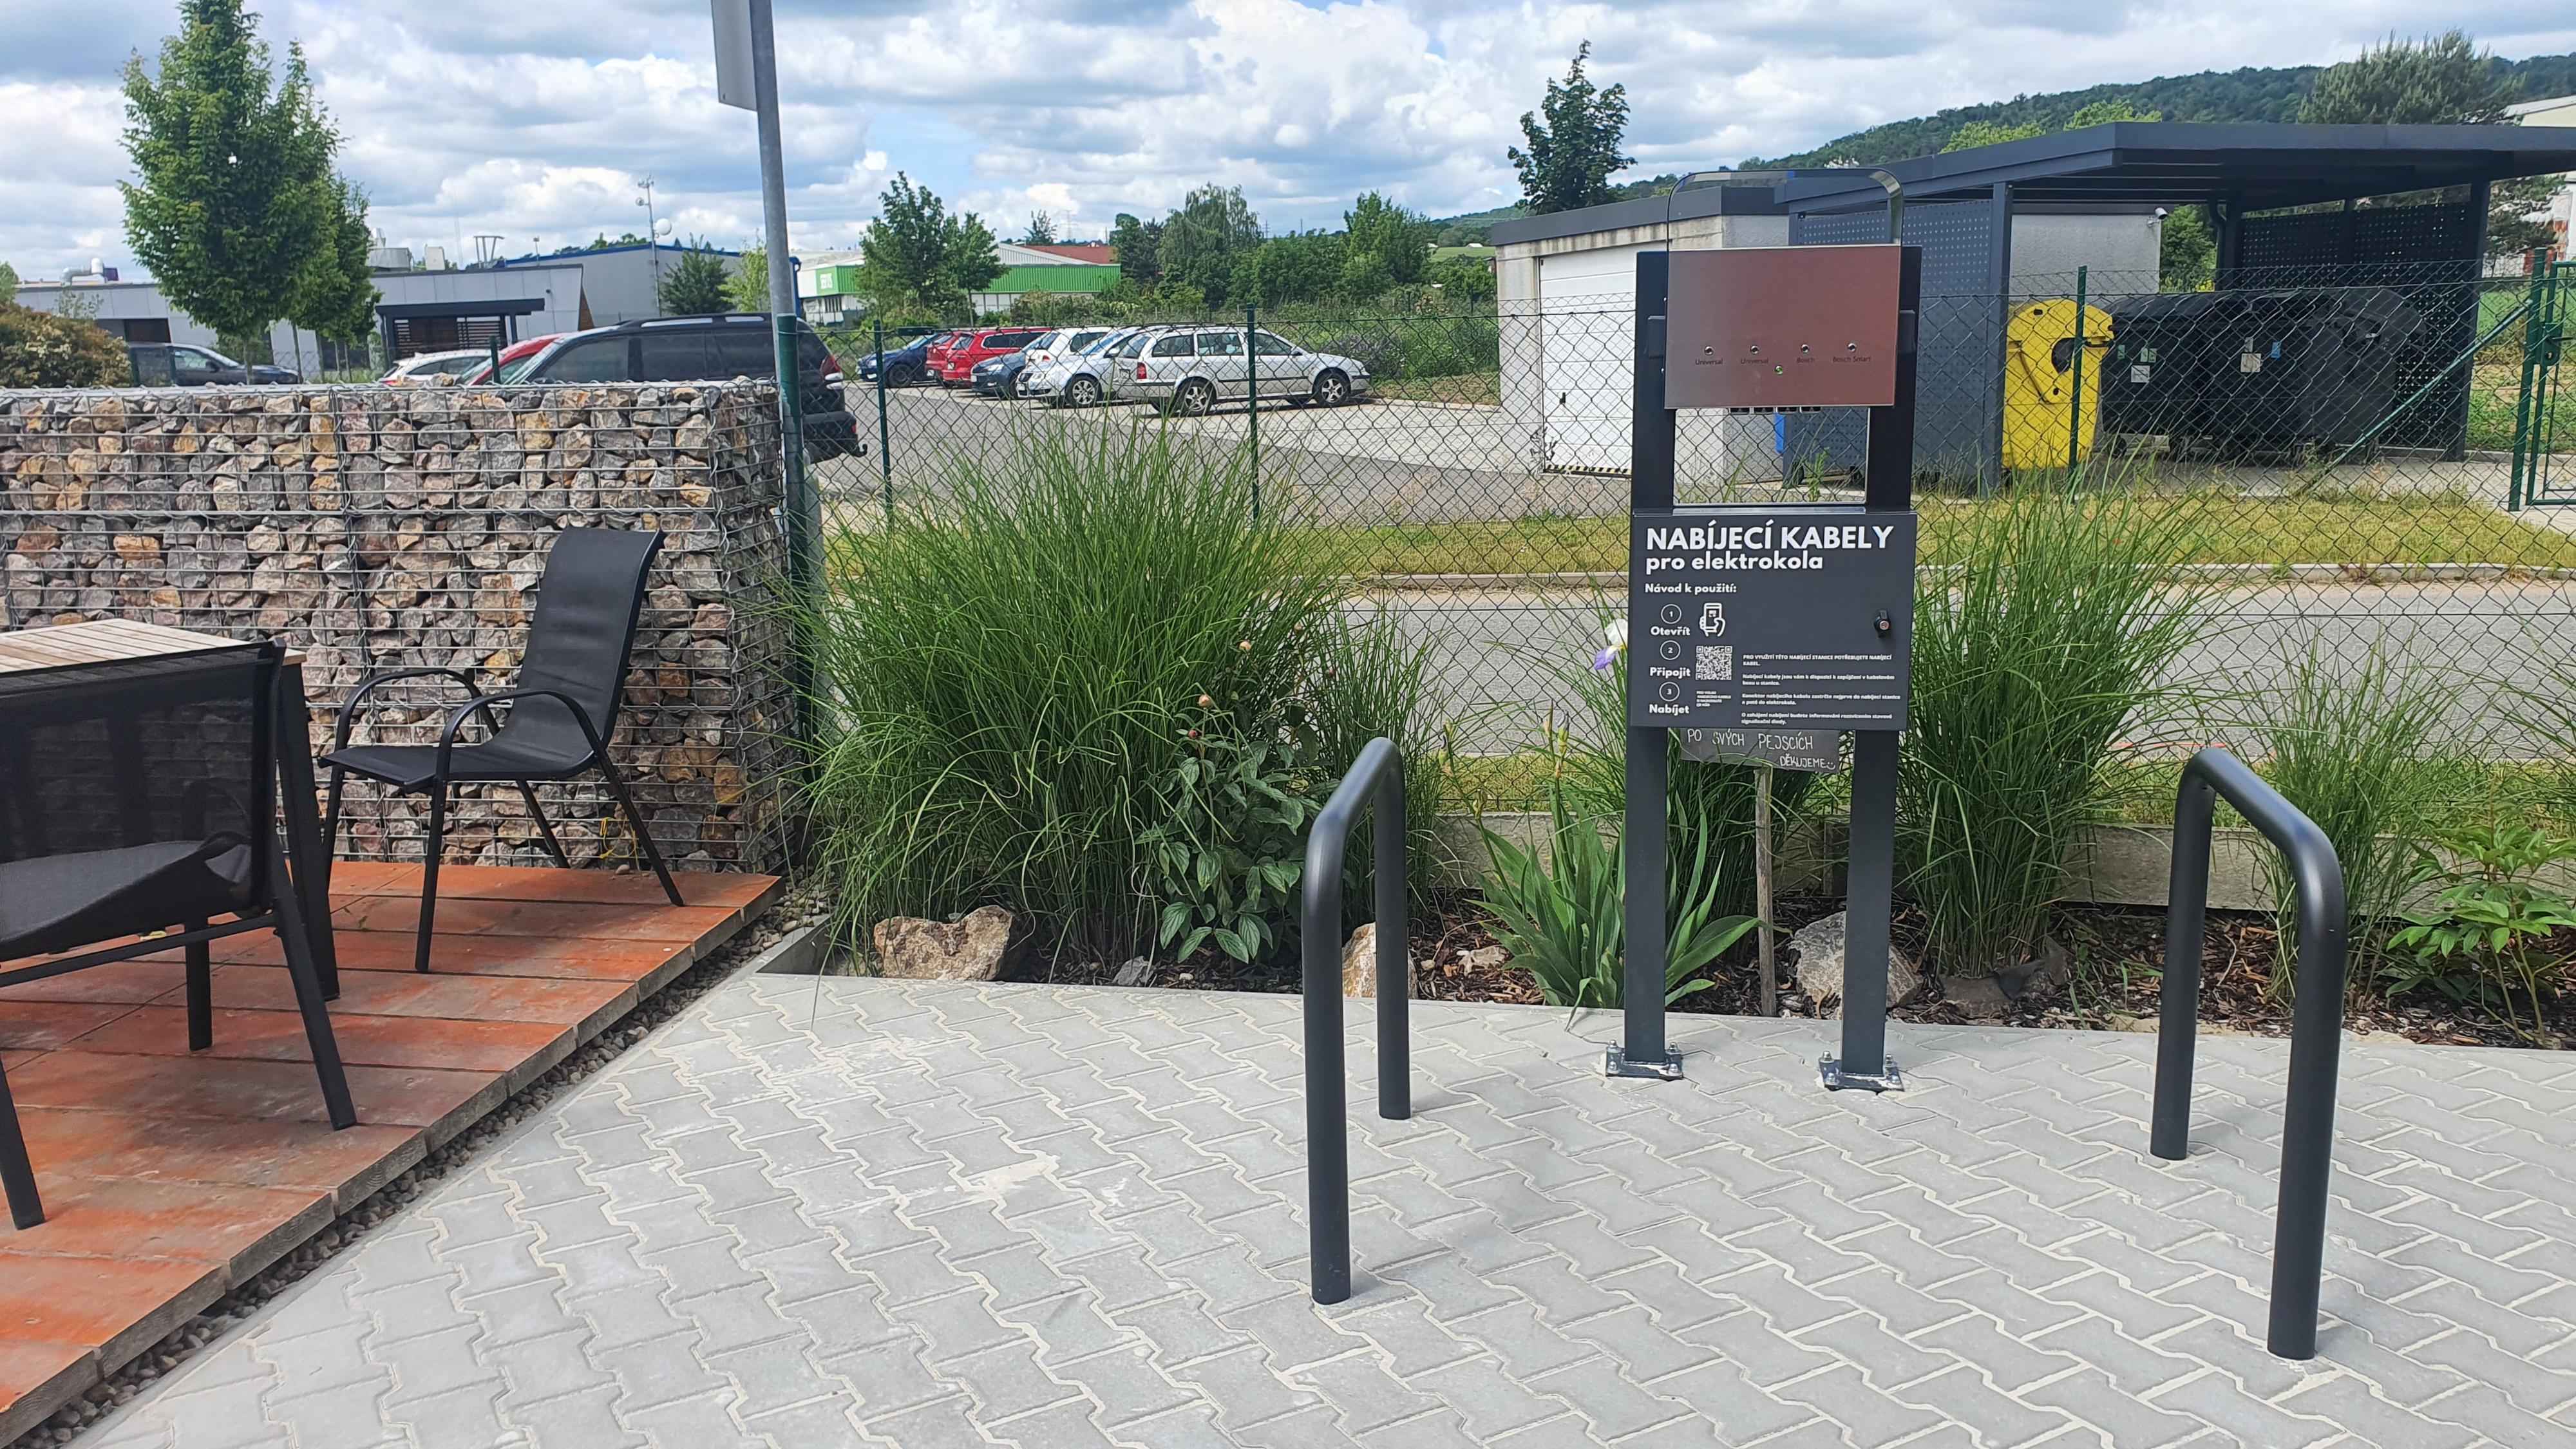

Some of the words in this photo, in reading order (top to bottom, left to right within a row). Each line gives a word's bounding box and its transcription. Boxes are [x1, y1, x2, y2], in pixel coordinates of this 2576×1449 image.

[1647, 519, 1774, 550] NABÍJECÍ
[1781, 526, 1894, 549] KABELY
[1646, 558, 1685, 575] pro
[1691, 550, 1823, 570] elektrokola
[1645, 583, 1682, 593] Návod
[1685, 583, 1692, 593] k
[1694, 583, 1737, 595] použití:
[1651, 626, 1690, 636] Otevřít
[1649, 667, 1691, 679] Připojit
[1649, 704, 1690, 716] Nabíjet
[1687, 728, 1702, 743] PO
[1712, 728, 1745, 746] SVÝCH
[1758, 732, 1814, 751] PEJSCÍCH
[1780, 753, 1828, 768] DĚKUJEME
